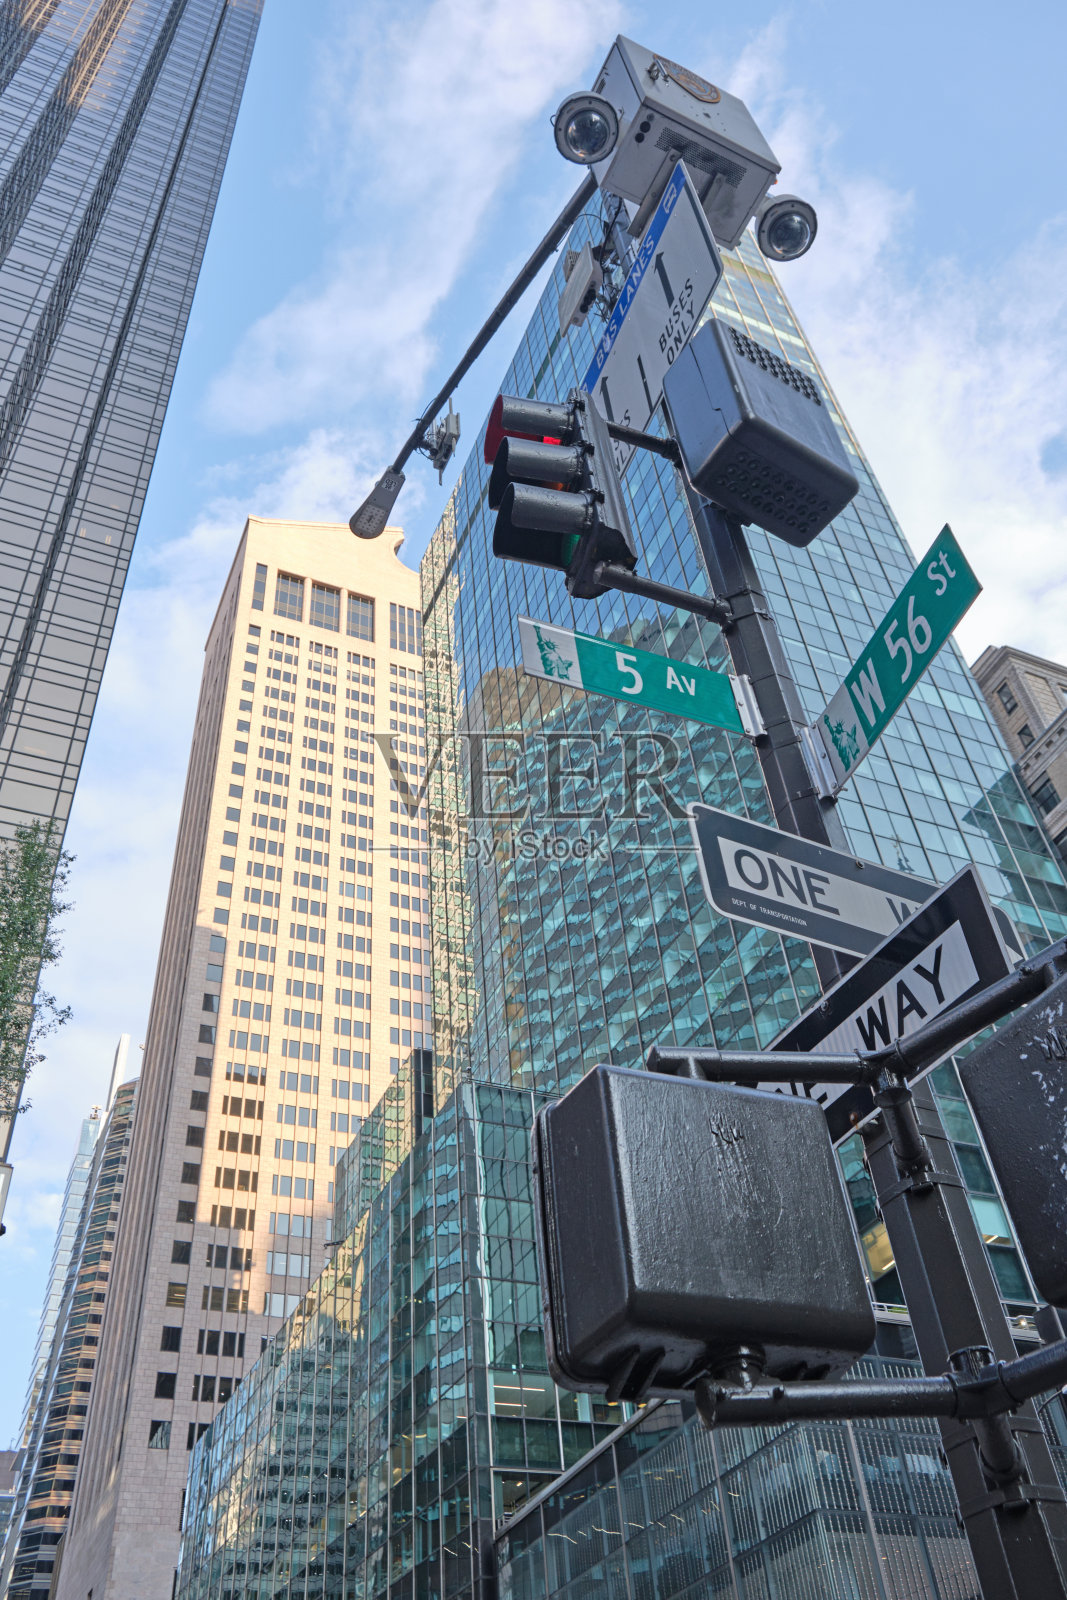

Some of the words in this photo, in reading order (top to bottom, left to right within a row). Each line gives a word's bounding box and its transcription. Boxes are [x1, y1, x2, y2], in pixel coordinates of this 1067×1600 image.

[597, 319, 617, 369] BUS
[619, 235, 654, 317] LANES
[659, 278, 693, 354] BUSES
[666, 299, 694, 365] ONLY
[616, 650, 644, 695] 5
[666, 666, 696, 697] Av
[850, 657, 886, 727] W
[883, 595, 932, 684] 56
[927, 550, 956, 596] St
[733, 849, 840, 916] ONE
[759, 906, 808, 927] TRANSPORTATION
[855, 943, 946, 1050] WAY
